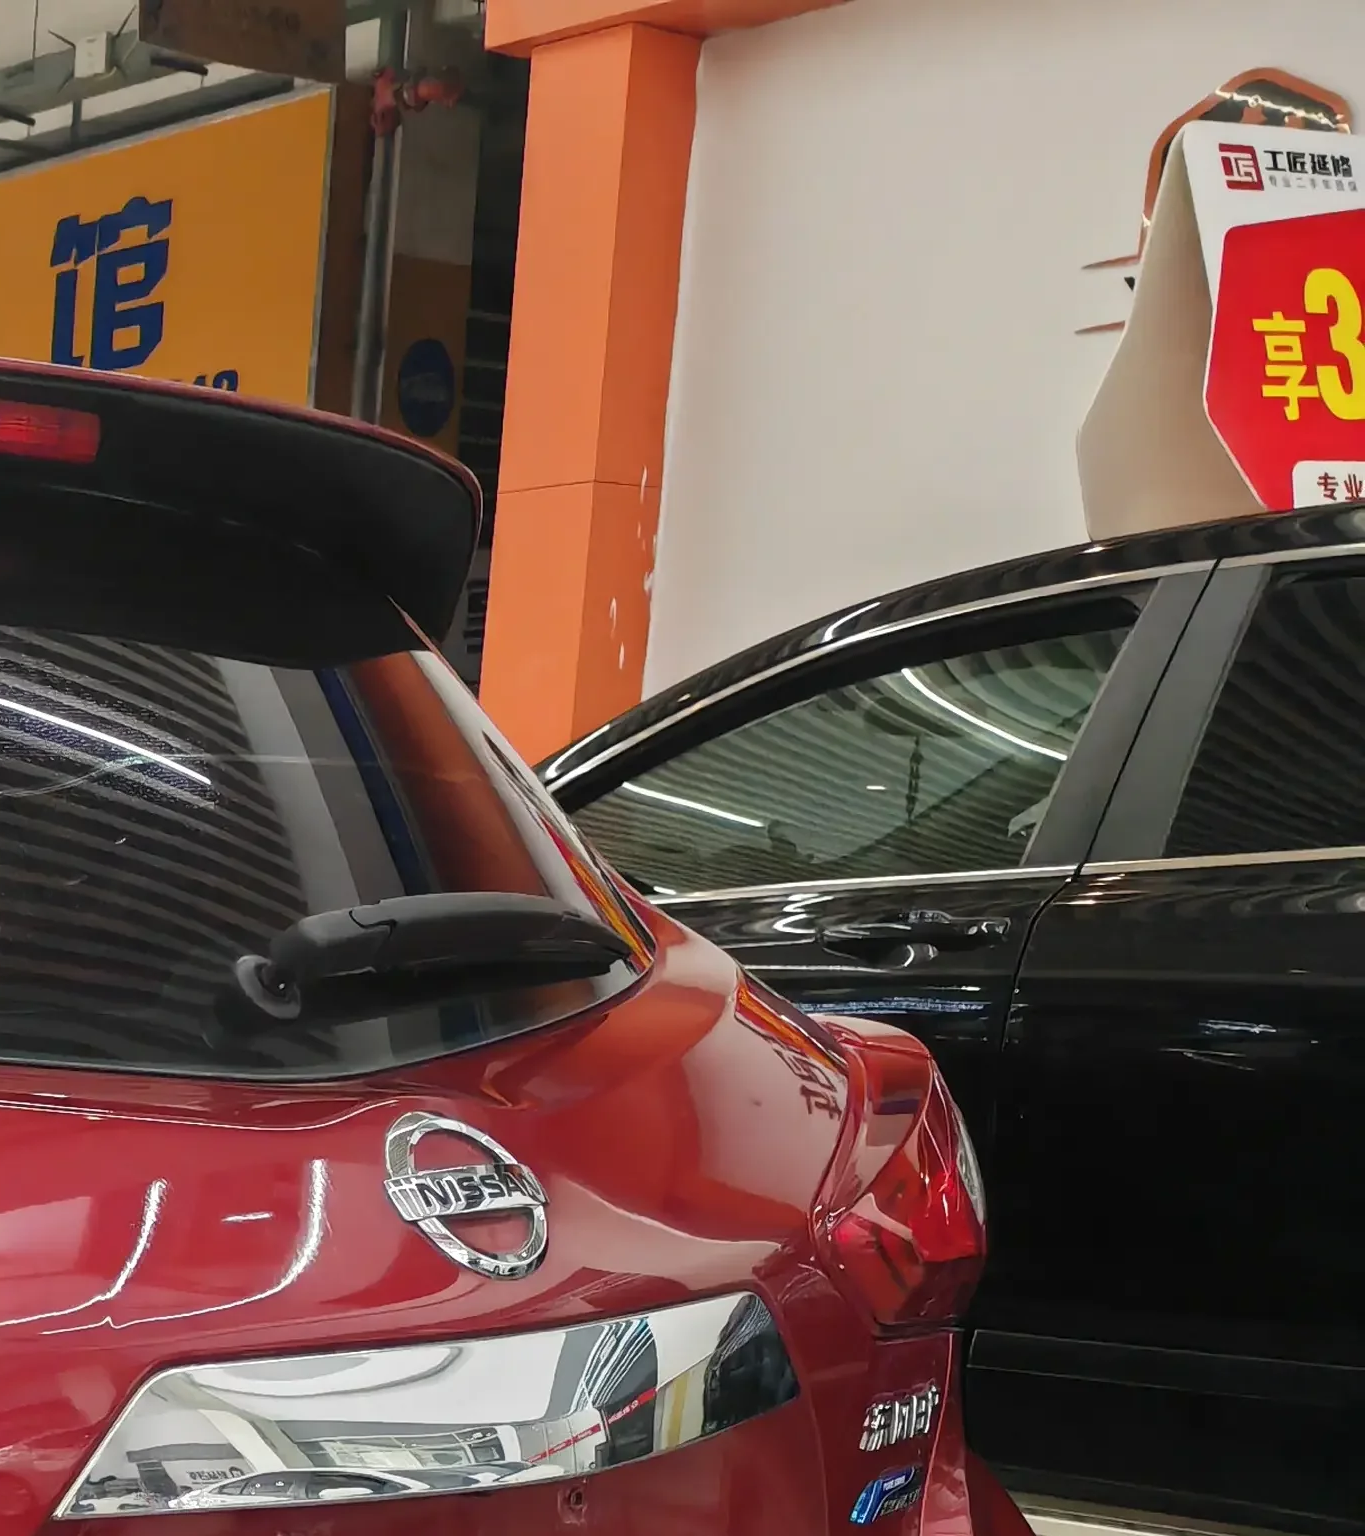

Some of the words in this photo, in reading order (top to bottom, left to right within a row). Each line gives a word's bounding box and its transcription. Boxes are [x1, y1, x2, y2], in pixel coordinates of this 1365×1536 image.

[1263, 150, 1353, 178] 工匠延修
[415, 1169, 543, 1209] NISSAN
